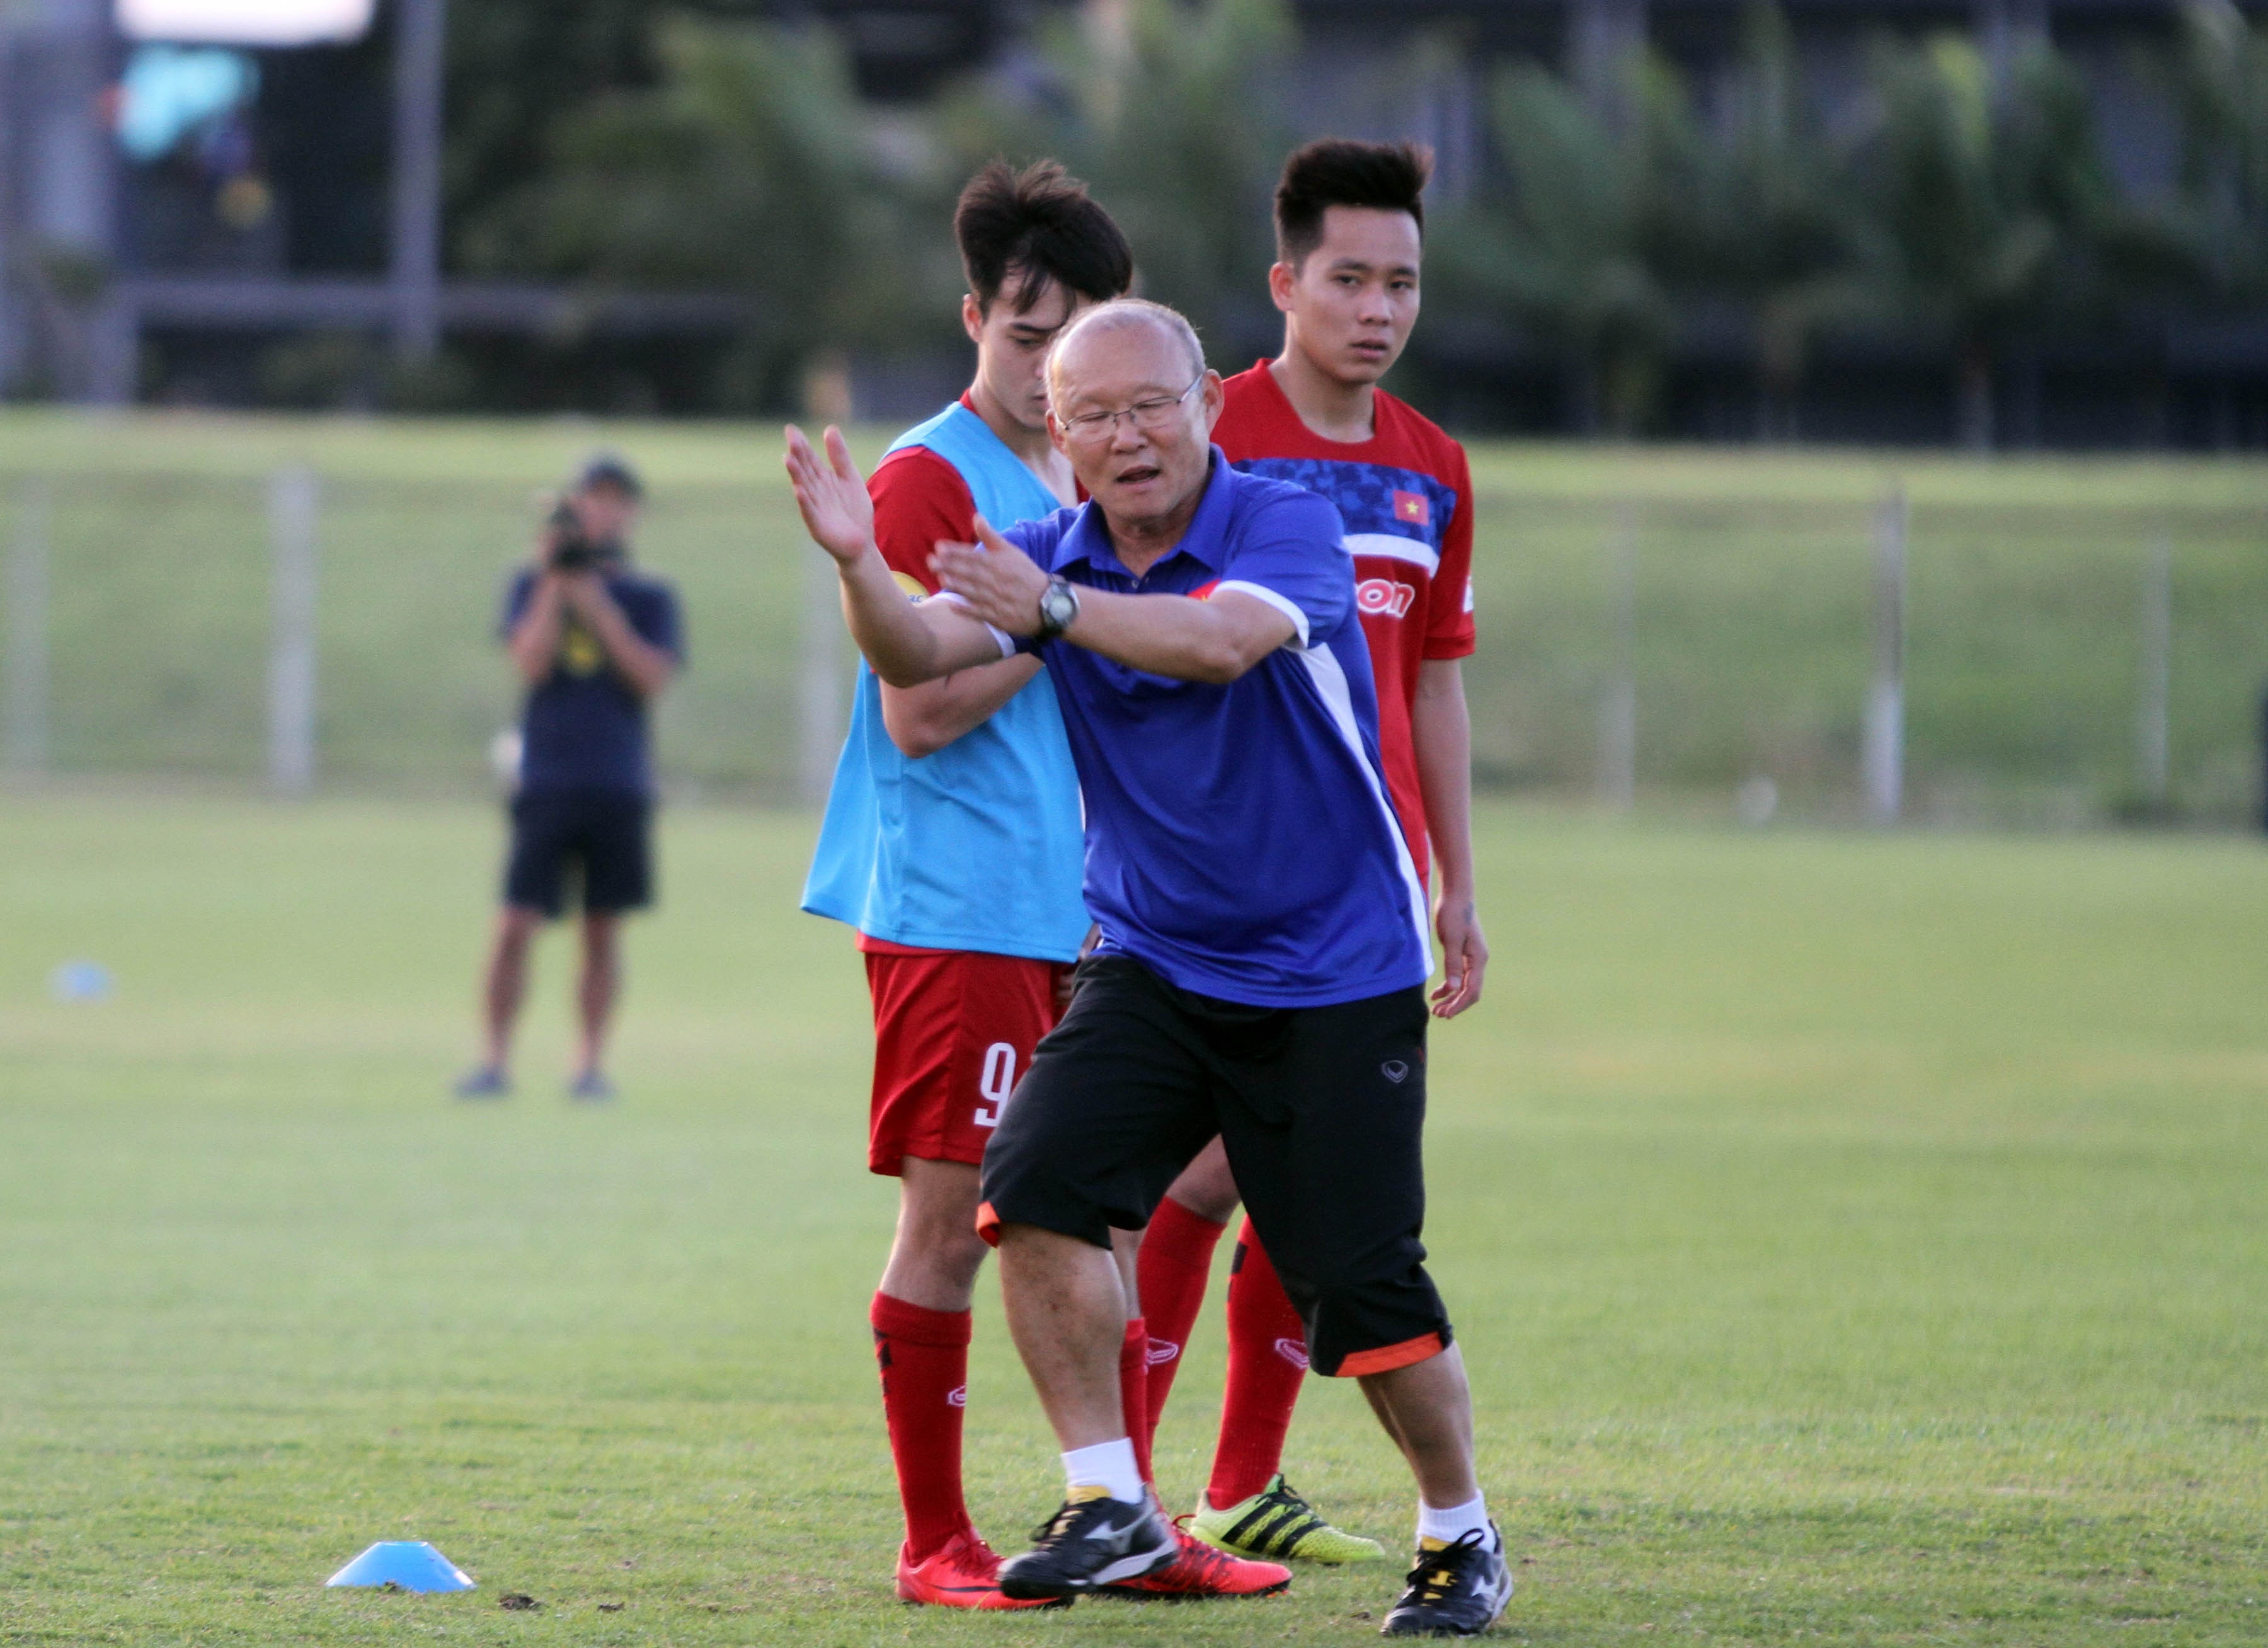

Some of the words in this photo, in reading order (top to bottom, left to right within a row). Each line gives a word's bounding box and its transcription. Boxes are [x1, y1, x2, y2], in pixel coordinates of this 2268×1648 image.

[908, 594, 923, 603] ac
[1355, 578, 1416, 618] on
[974, 1042, 1016, 1127] 9
